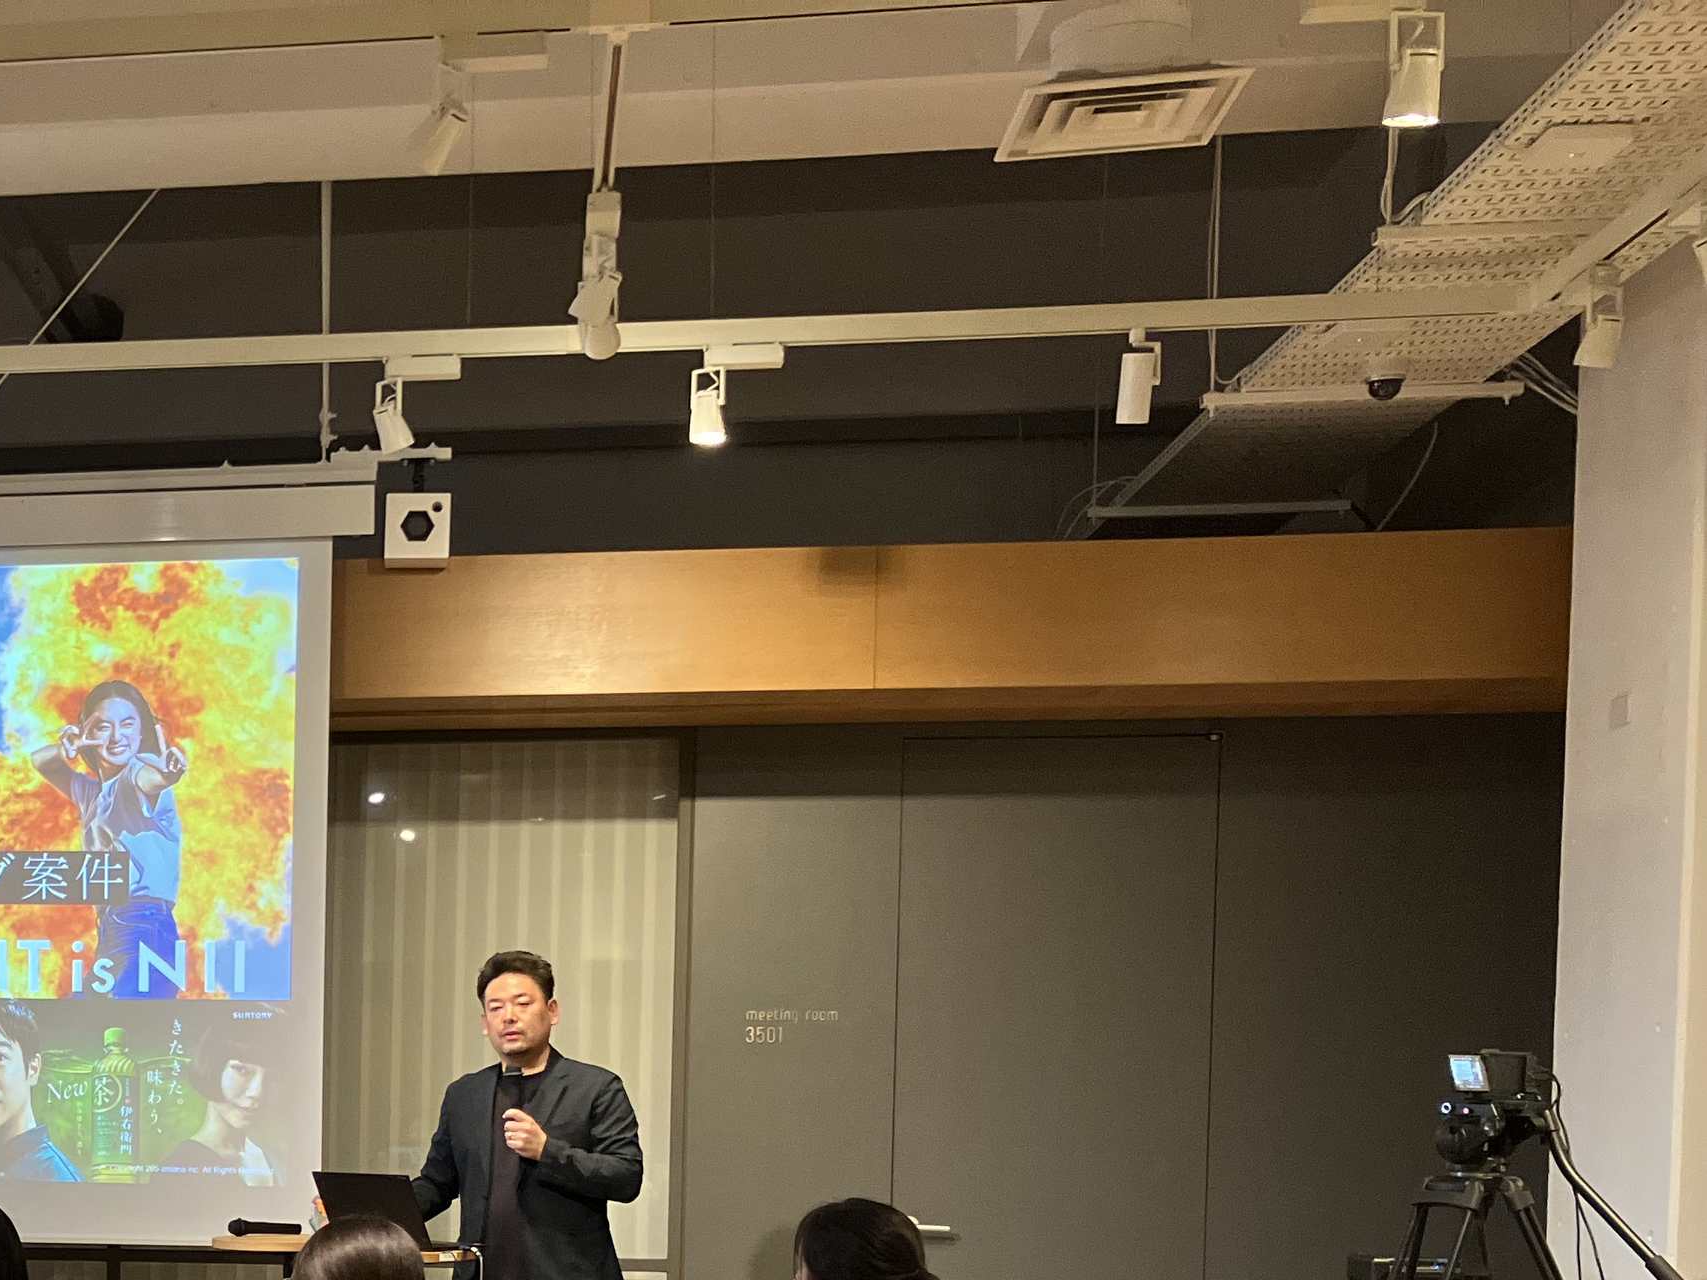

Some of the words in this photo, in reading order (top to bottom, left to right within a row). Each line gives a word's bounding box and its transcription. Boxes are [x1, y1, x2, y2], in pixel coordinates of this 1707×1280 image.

[71, 940, 115, 993] is
[745, 1008, 798, 1023] meeting
[805, 1009, 839, 1021] room
[745, 1026, 783, 1043] 3501
[169, 1018, 185, 1105] きたきた。
[47, 1080, 89, 1104] New
[94, 1076, 115, 1106] 茶
[147, 1069, 163, 1134] 味わう、
[120, 1105, 134, 1156] 伊右衛門
